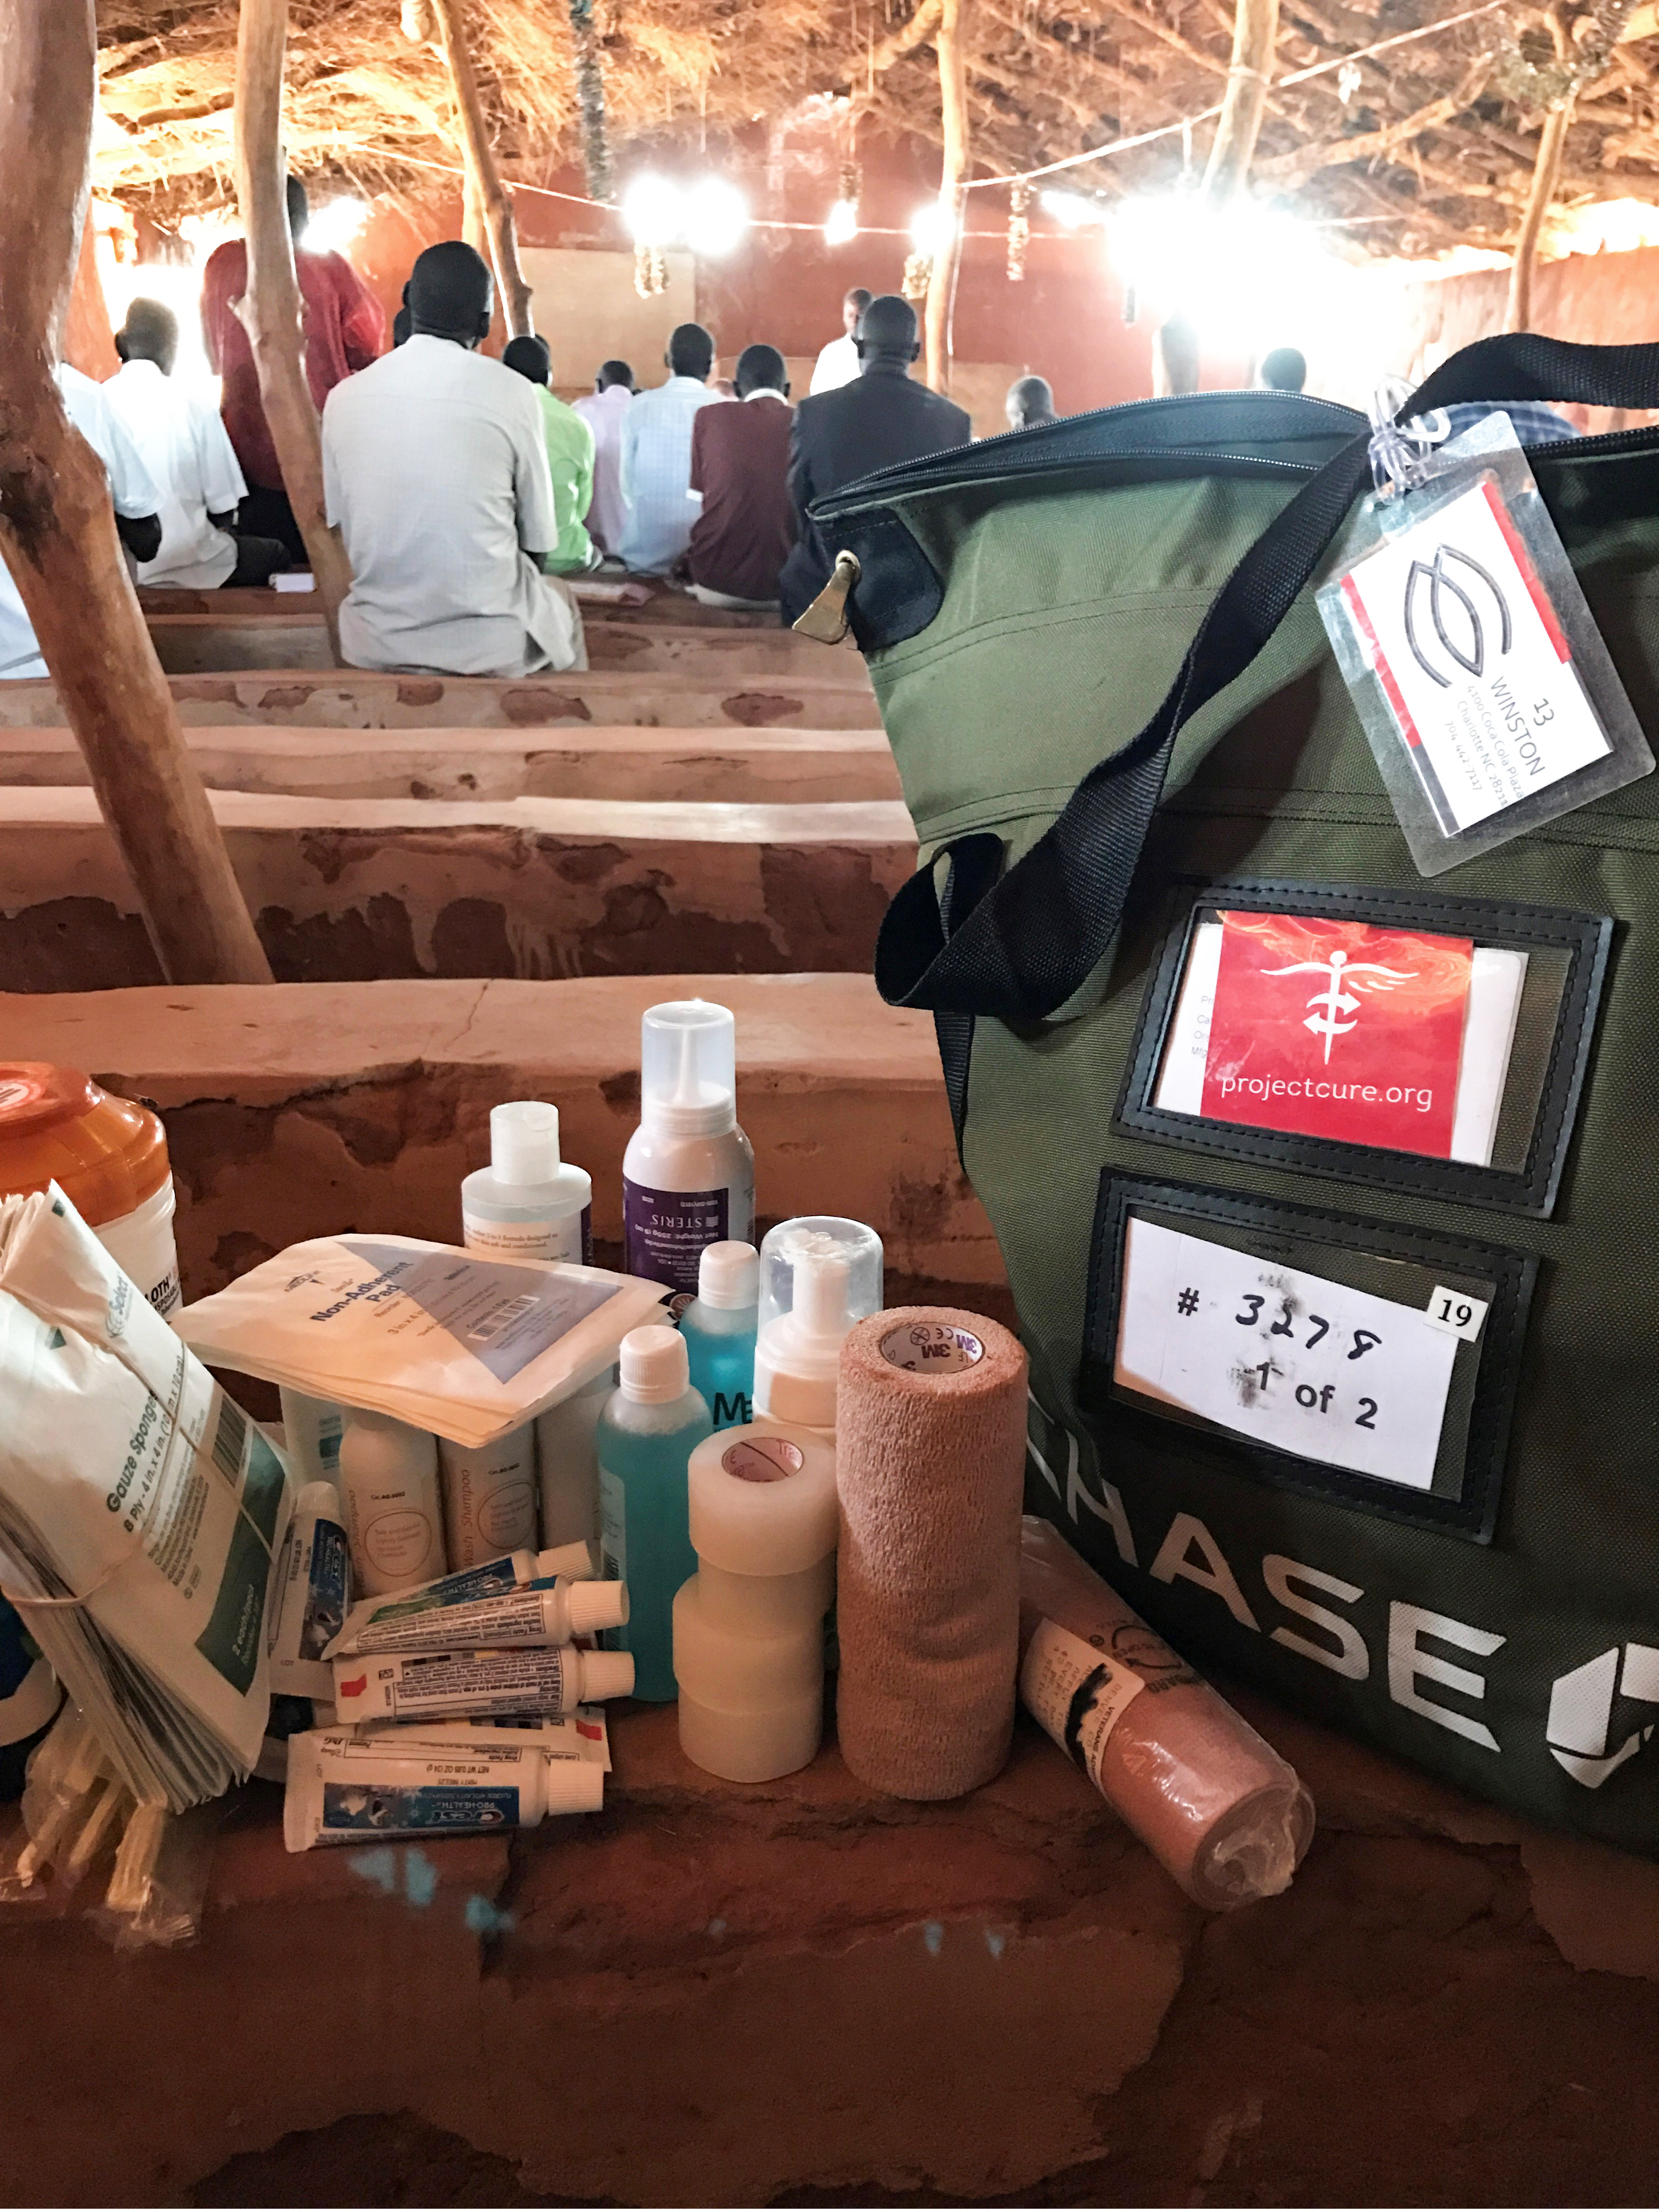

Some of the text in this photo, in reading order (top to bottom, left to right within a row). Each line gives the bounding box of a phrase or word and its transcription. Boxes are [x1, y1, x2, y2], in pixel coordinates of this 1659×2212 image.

[1490, 676, 1545, 775] WINSTON
[1533, 698, 1553, 727] 13
[1456, 700, 1483, 753] Charlotte
[1480, 753, 1495, 771] NC
[1466, 685, 1525, 799] 4100 Coca Cola Plaza
[1222, 1077, 1432, 1112] projectcure.org
[651, 1214, 702, 1228] STERIS
[311, 1262, 412, 1322] Non-Adherent
[366, 1285, 400, 1302] Pad
[1177, 1287, 1199, 1317] #
[1437, 1299, 1472, 1327] 19
[921, 1344, 950, 1358] 3M
[956, 1334, 977, 1353] 3M
[1295, 1385, 1335, 1414] of
[1356, 1398, 1379, 1429] 2
[150, 1447, 162, 1458] 4
[106, 1456, 138, 1513] Gauze
[143, 1481, 150, 1491] 4
[145, 1466, 156, 1483] in.
[129, 1499, 143, 1520] Ply
[461, 1469, 473, 1526] Shampoo
[126, 1521, 134, 1533] 8
[1094, 1707, 1114, 1751] VETERANS
